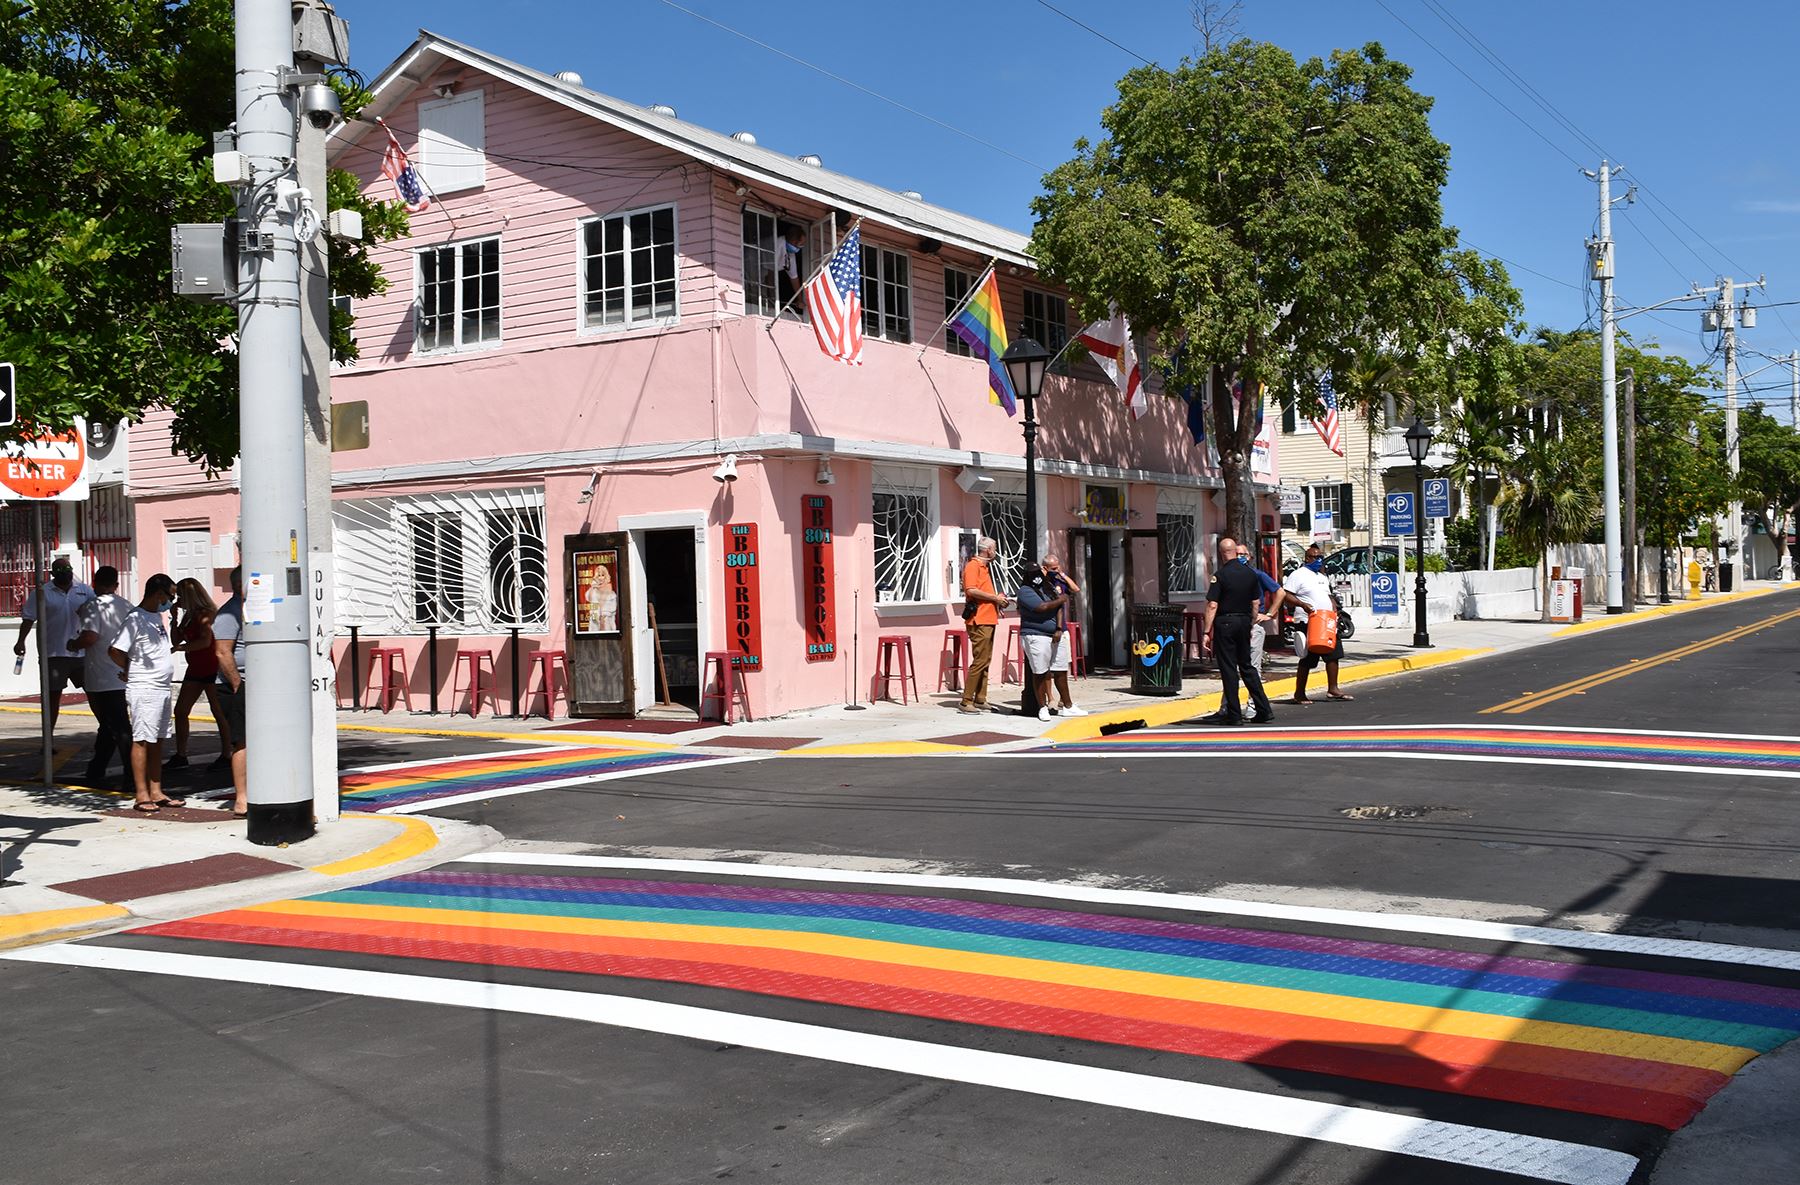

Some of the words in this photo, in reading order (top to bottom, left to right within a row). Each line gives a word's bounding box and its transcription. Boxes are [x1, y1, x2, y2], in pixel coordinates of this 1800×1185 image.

[8, 463, 66, 480] ENTER
[731, 525, 751, 535] THE
[805, 528, 832, 543] 801
[726, 552, 757, 568] 801
[315, 569, 324, 657] DUVAL
[808, 643, 835, 654] BAR
[730, 655, 760, 665] BAR
[311, 677, 329, 692] ST
